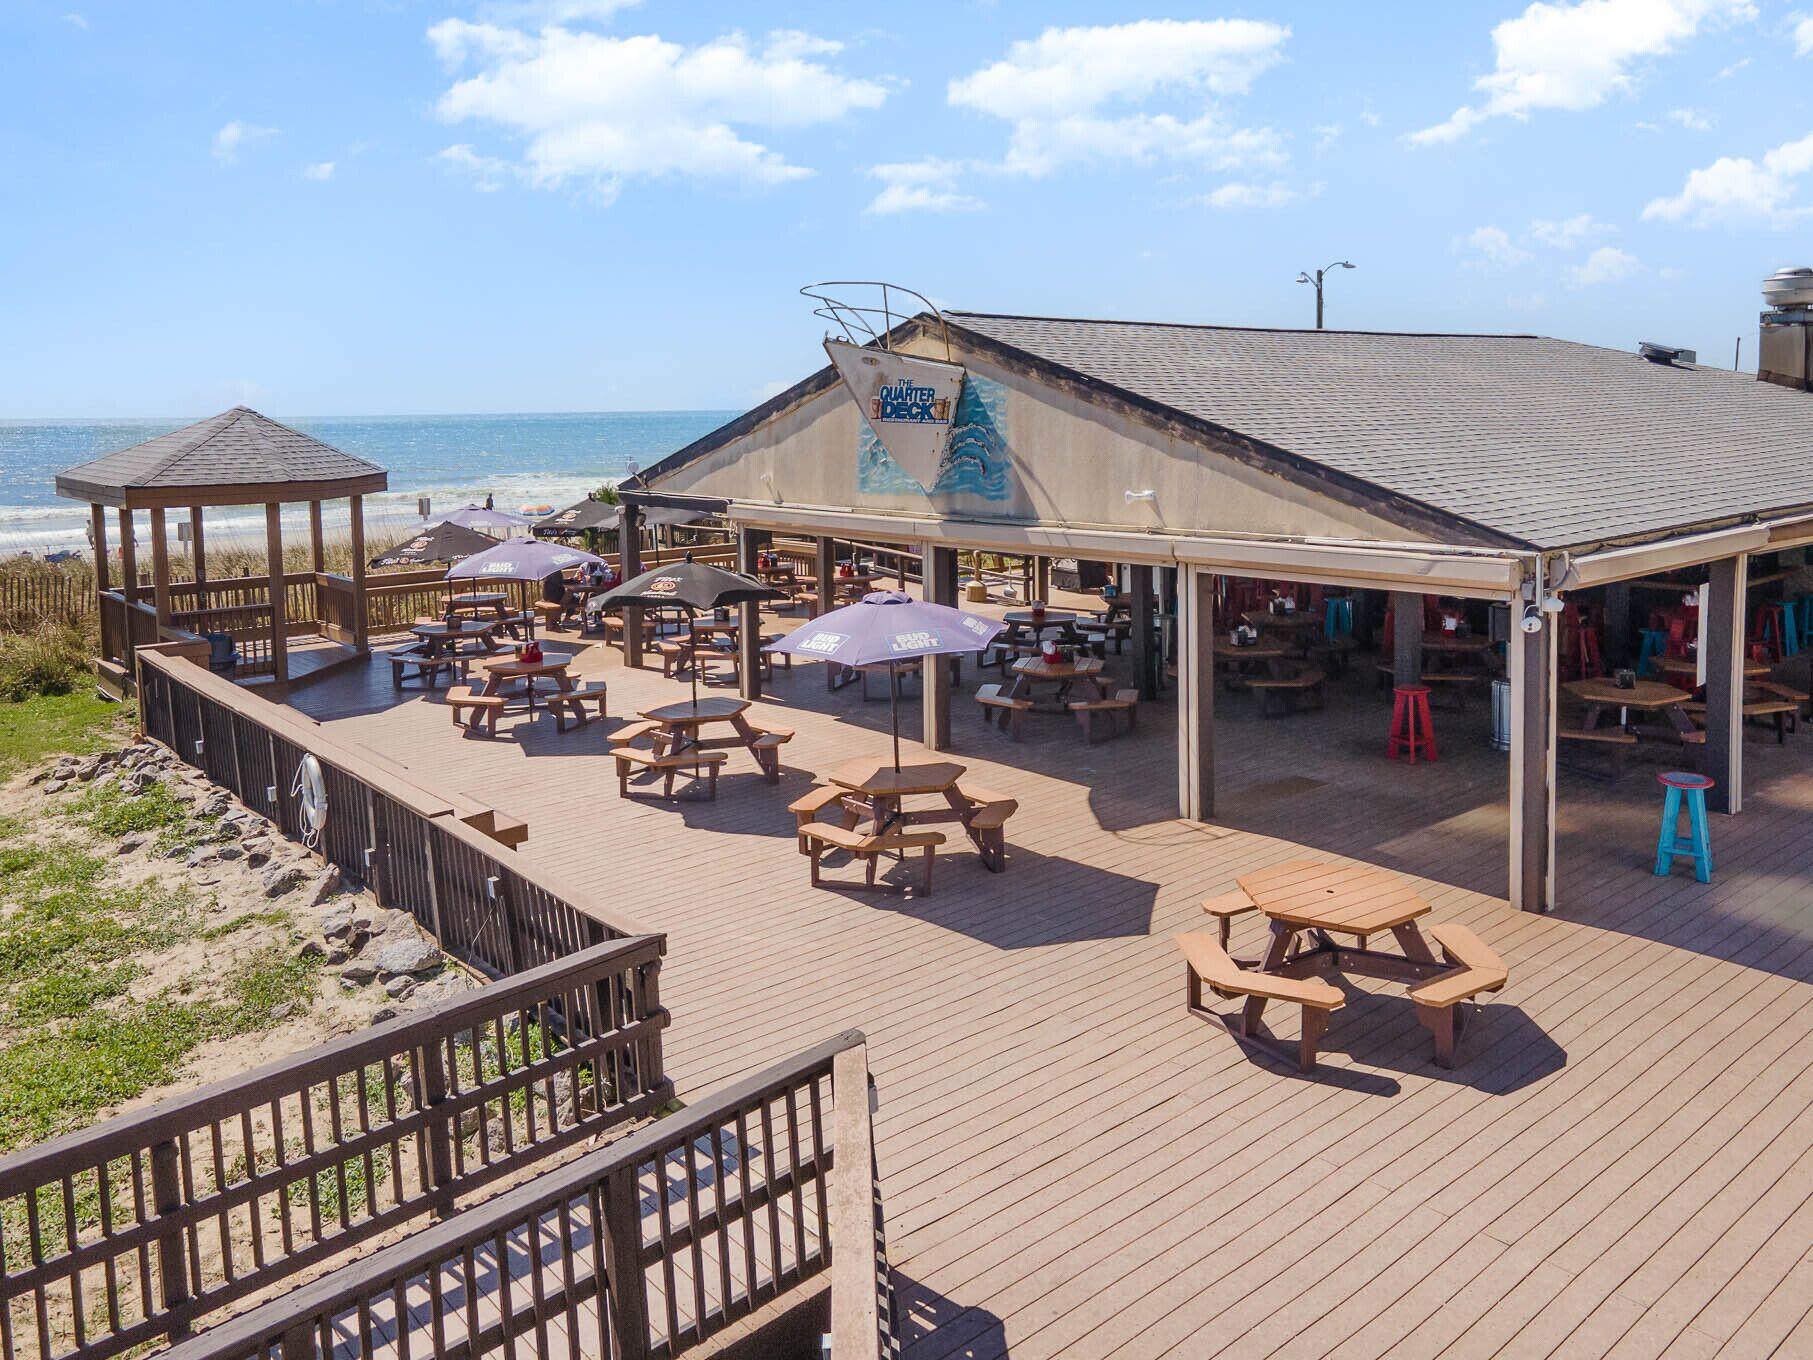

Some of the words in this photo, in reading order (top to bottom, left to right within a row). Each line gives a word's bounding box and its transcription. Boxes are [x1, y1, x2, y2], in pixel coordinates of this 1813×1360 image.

[898, 379, 914, 387] THE
[880, 385, 935, 402] QUARTER
[881, 401, 936, 419] DECK
[814, 632, 841, 643] BUD
[895, 631, 930, 642] BUD
[801, 640, 840, 652] LIGHT
[892, 638, 939, 652] LIGHT
